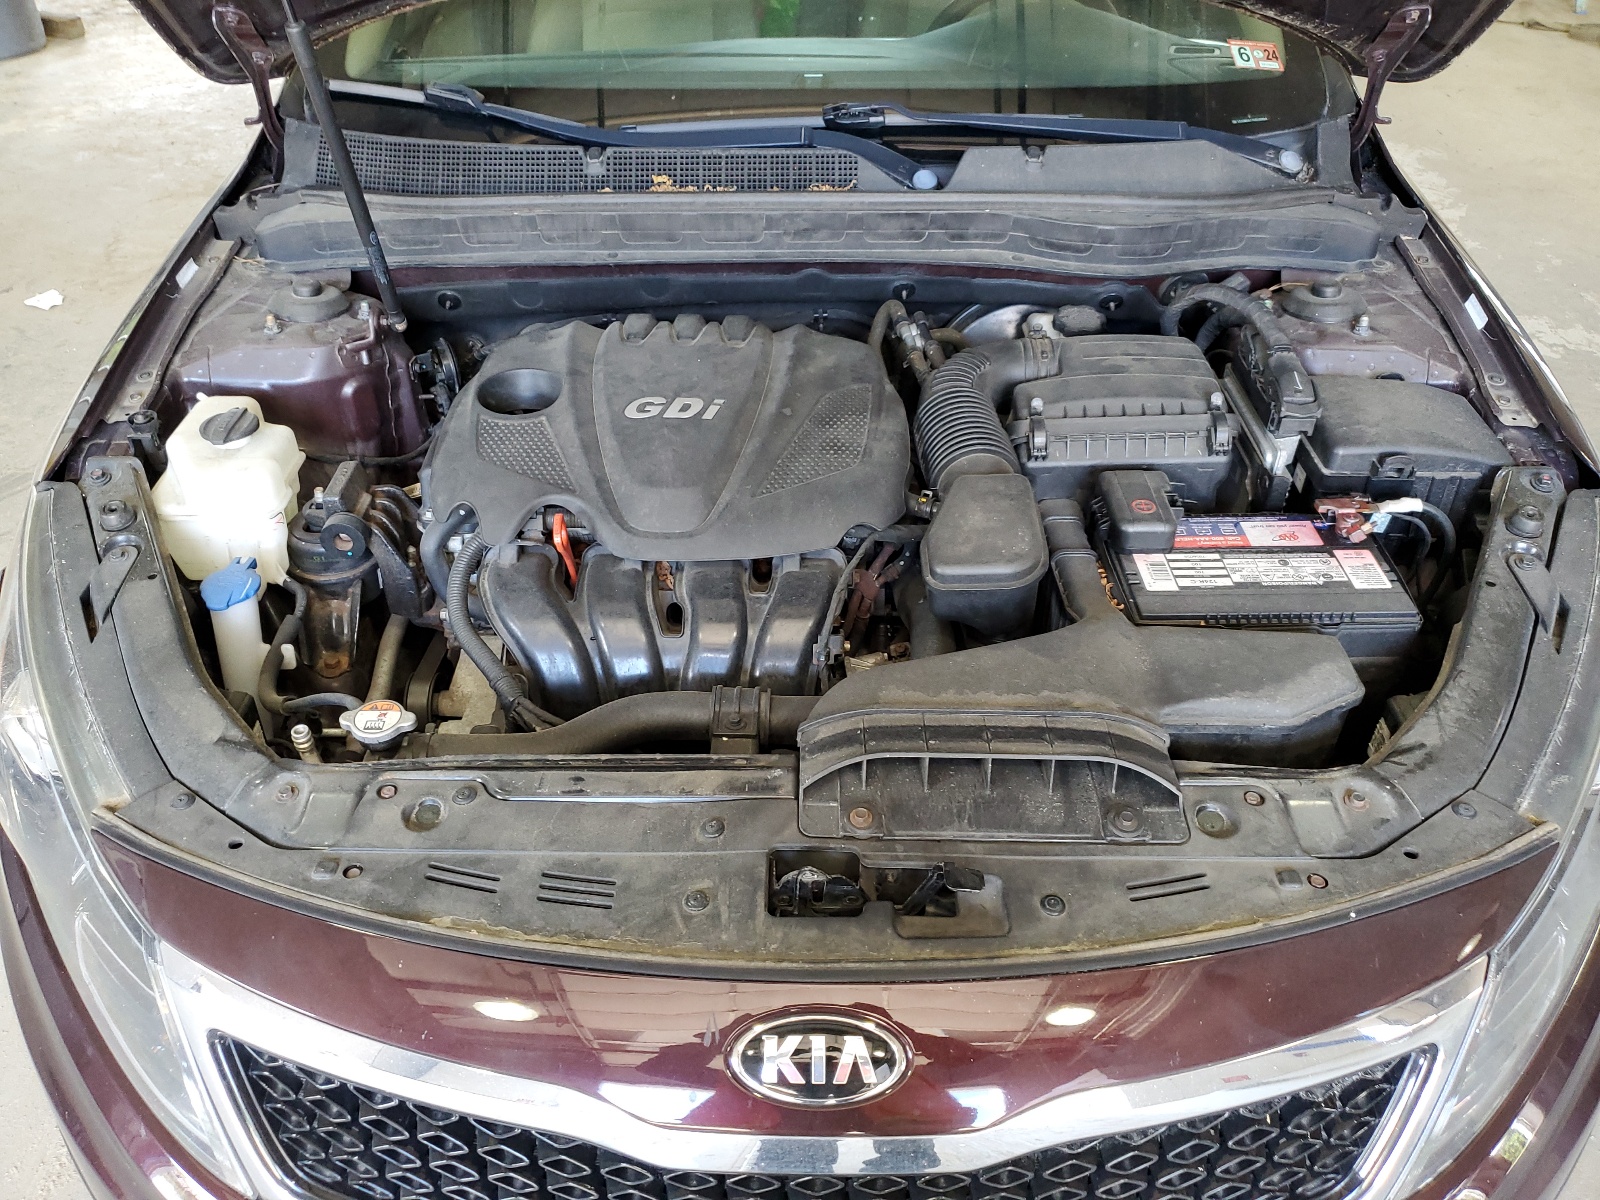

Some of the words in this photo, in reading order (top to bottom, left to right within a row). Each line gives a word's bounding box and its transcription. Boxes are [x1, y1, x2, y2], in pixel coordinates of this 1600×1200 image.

[1238, 47, 1250, 62] 6
[1264, 49, 1279, 61] 24
[624, 396, 726, 420] GDi
[761, 1035, 878, 1085] KIA
